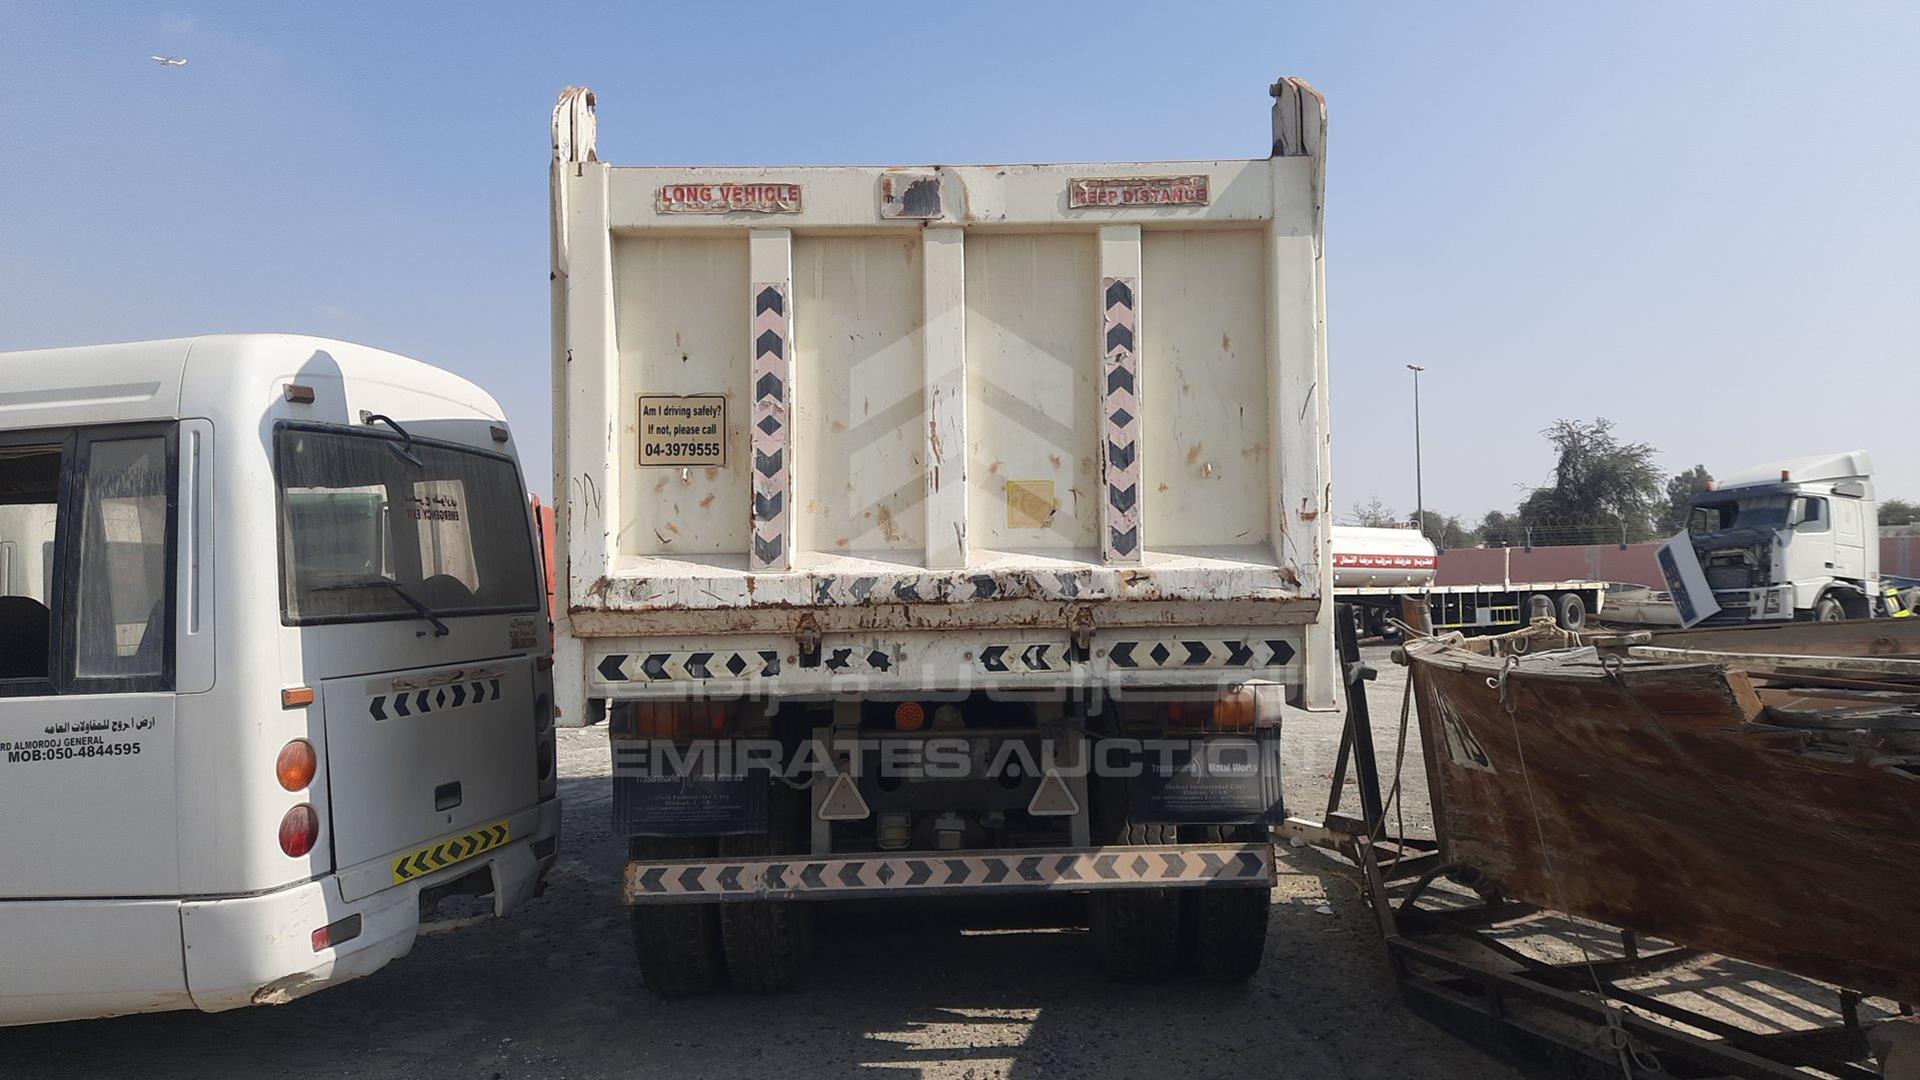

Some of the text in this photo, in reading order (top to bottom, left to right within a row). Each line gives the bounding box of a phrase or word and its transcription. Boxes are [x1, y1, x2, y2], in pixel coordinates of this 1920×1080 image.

[662, 186, 798, 202] LONG VEHICLE
[1074, 188, 1207, 204] KEEP DISTANCE
[643, 405, 722, 418] Am I driving safely?
[648, 424, 717, 437] If not, please call
[645, 443, 720, 457] 04-3979555
[14, 738, 62, 750] ALMOROOJ
[63, 736, 105, 747] GENERAL
[8, 742, 141, 763] MOB:050-4844595
